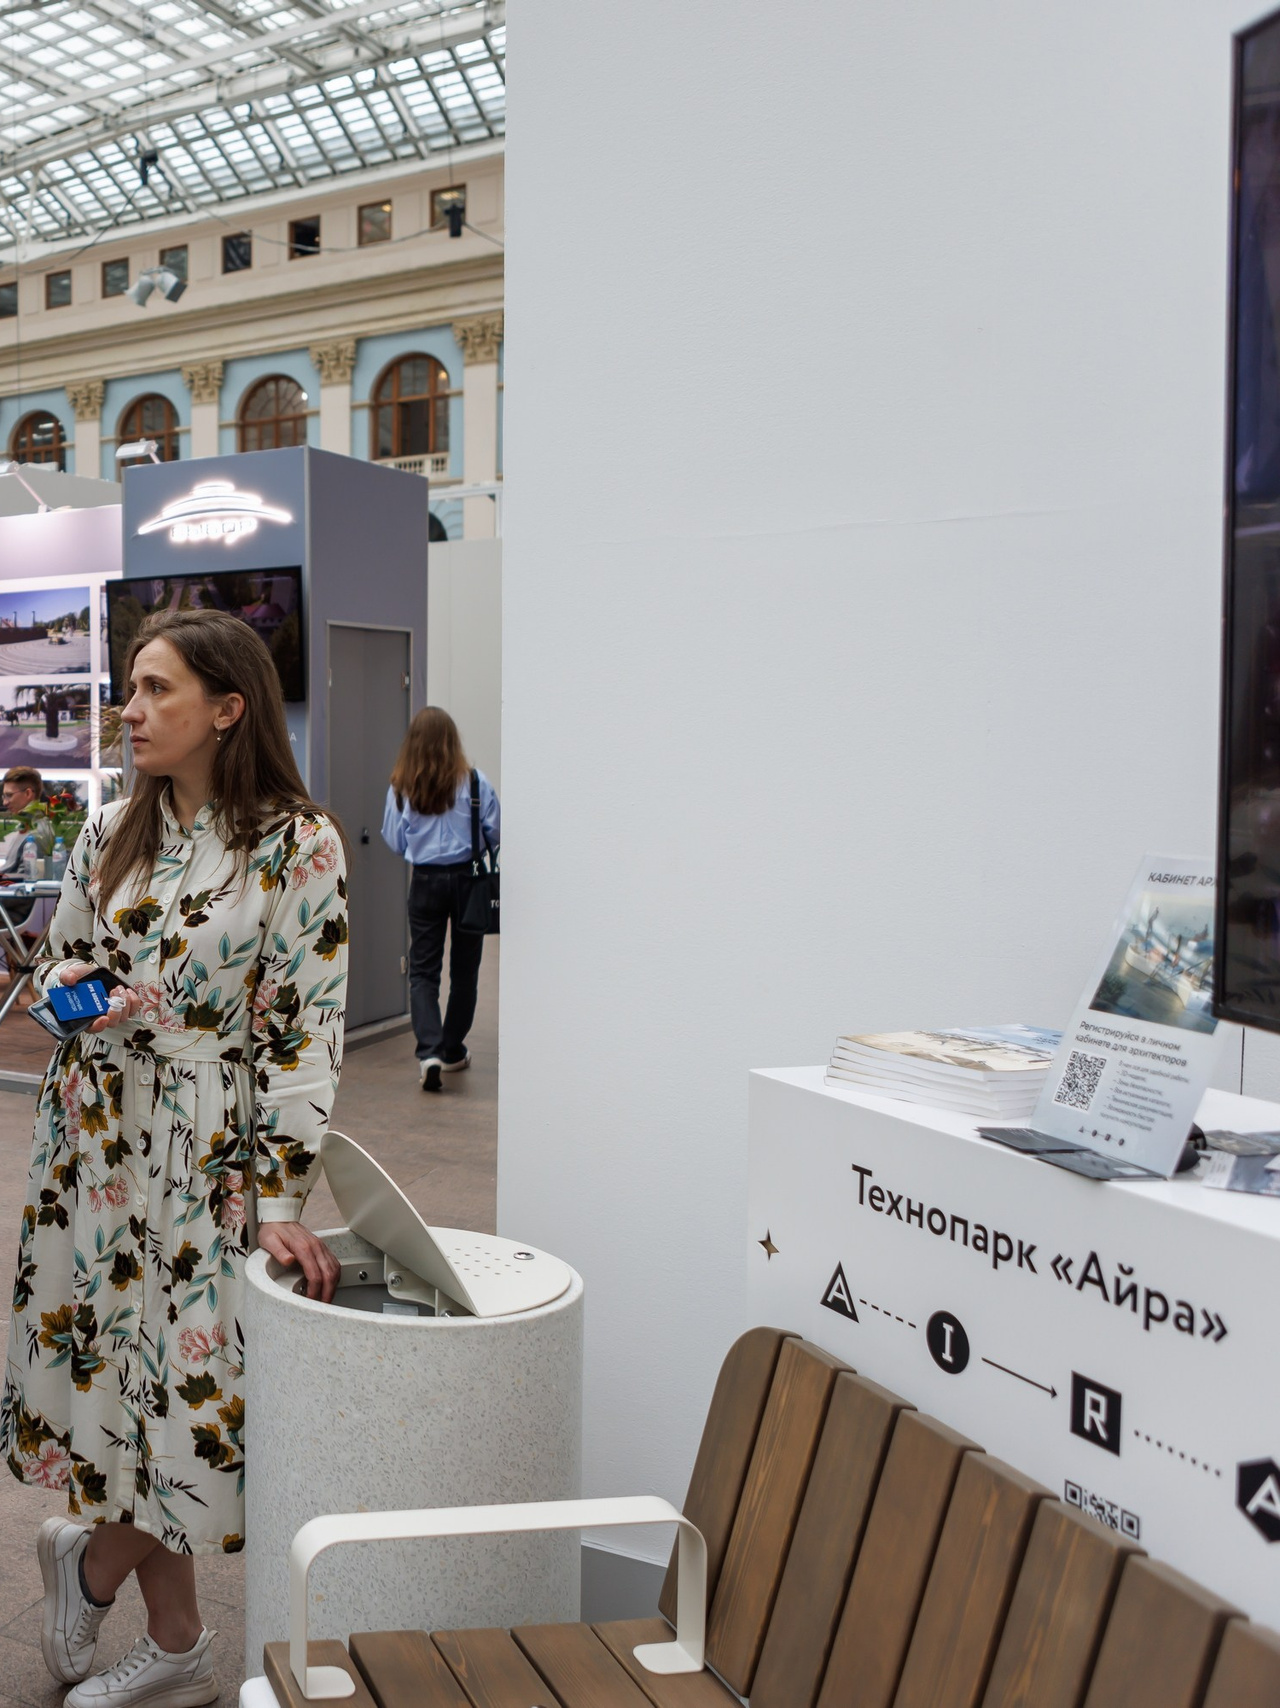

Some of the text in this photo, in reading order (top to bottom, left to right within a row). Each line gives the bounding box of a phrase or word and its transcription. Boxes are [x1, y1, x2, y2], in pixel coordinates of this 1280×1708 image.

[1148, 872, 1197, 886] КАБИНЕТ
[1075, 1034, 1111, 1049] кабинете
[1111, 1043, 1128, 1053] для
[1128, 1046, 1187, 1067] архитекторов
[1079, 1020, 1140, 1042] Регистрируйся
[1147, 1038, 1182, 1052] личном
[851, 1164, 1228, 1344] Технопарк «Айра»
